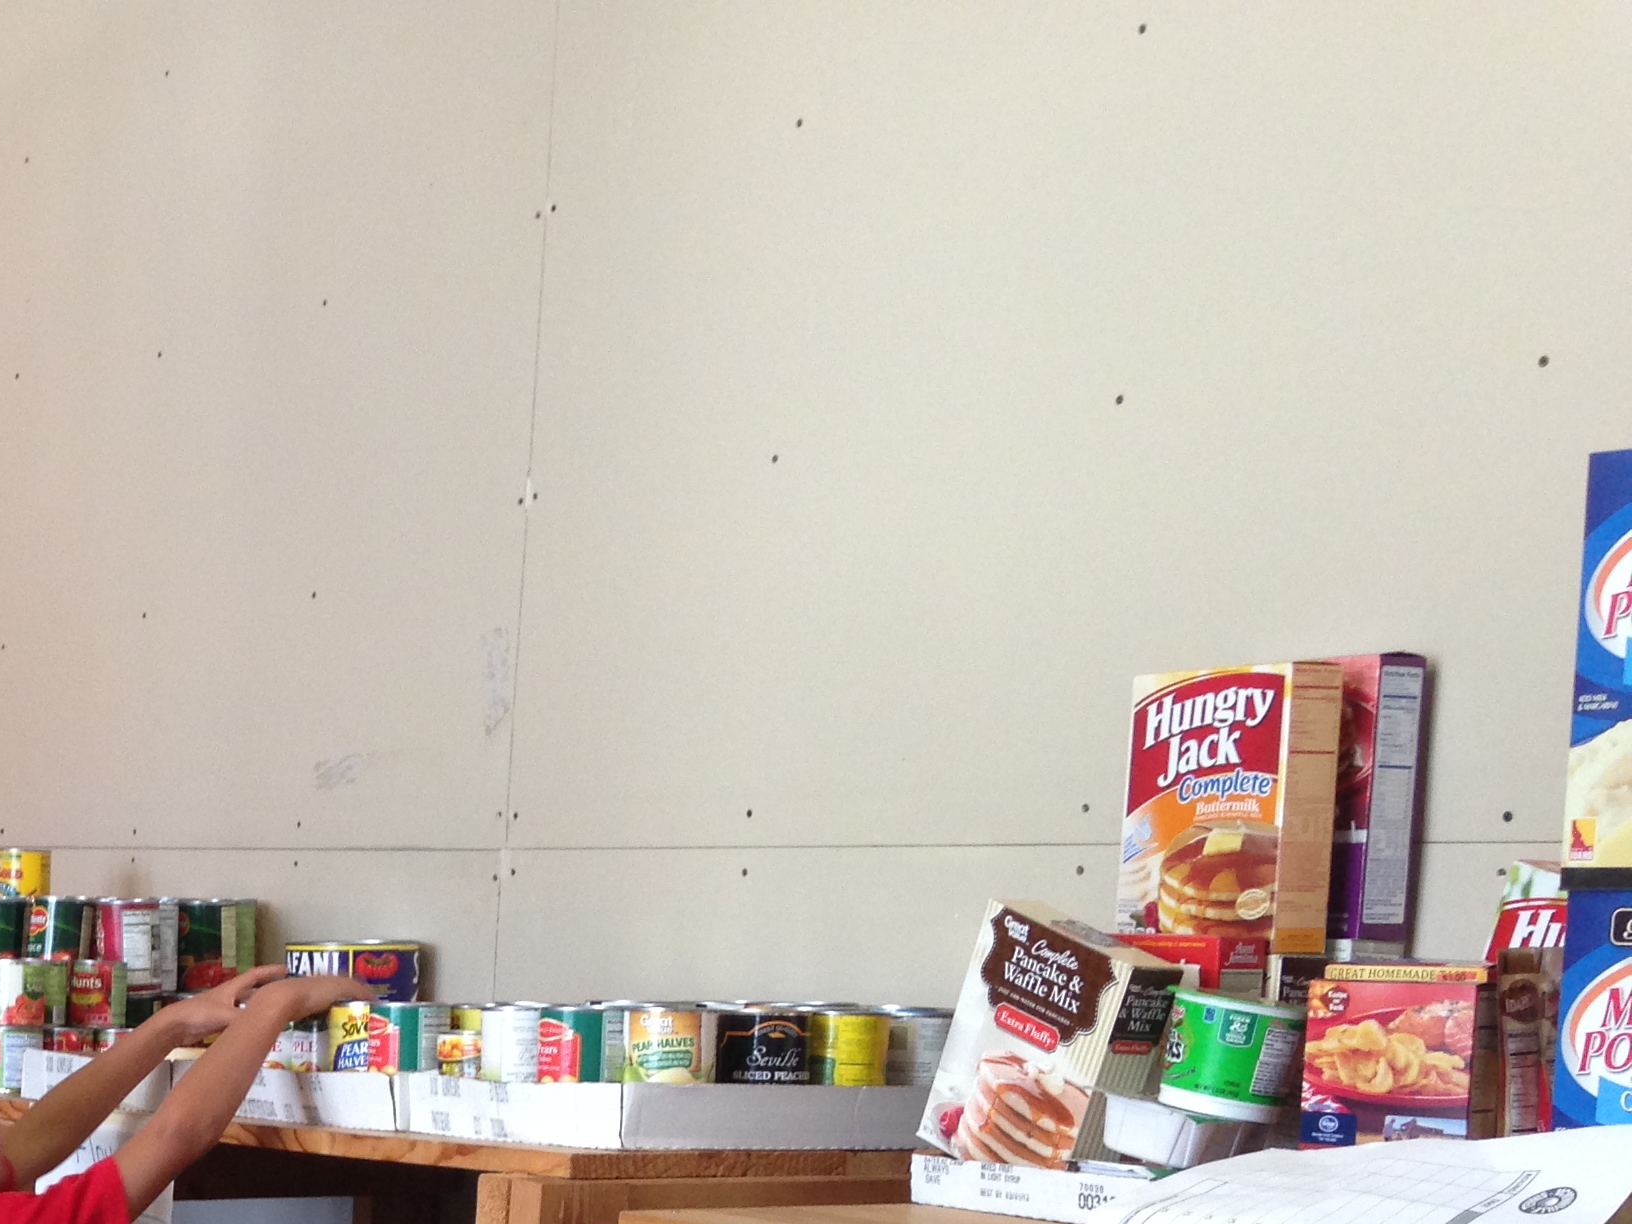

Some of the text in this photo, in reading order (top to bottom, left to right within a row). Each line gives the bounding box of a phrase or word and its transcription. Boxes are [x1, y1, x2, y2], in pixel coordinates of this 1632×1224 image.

[1144, 686, 1275, 750] Hungry
[1158, 726, 1241, 788] Jack
[1178, 768, 1271, 804] Complete
[1195, 799, 1260, 815] Buttermilk
[1031, 939, 1079, 970] Complete
[1011, 946, 1084, 994] Pancake &
[1330, 968, 1435, 980] GREAT HOMEMADE
[1004, 961, 1080, 1014] Waffle Mix
[1000, 1011, 1053, 1047] Extra Fluffy
[1127, 1020, 1151, 1032] Mix
[746, 1045, 801, 1067] Seville
[733, 1071, 771, 1080] SLICED
[925, 1175, 941, 1185] SAVE
[1004, 1174, 1021, 1184] SYRUP
